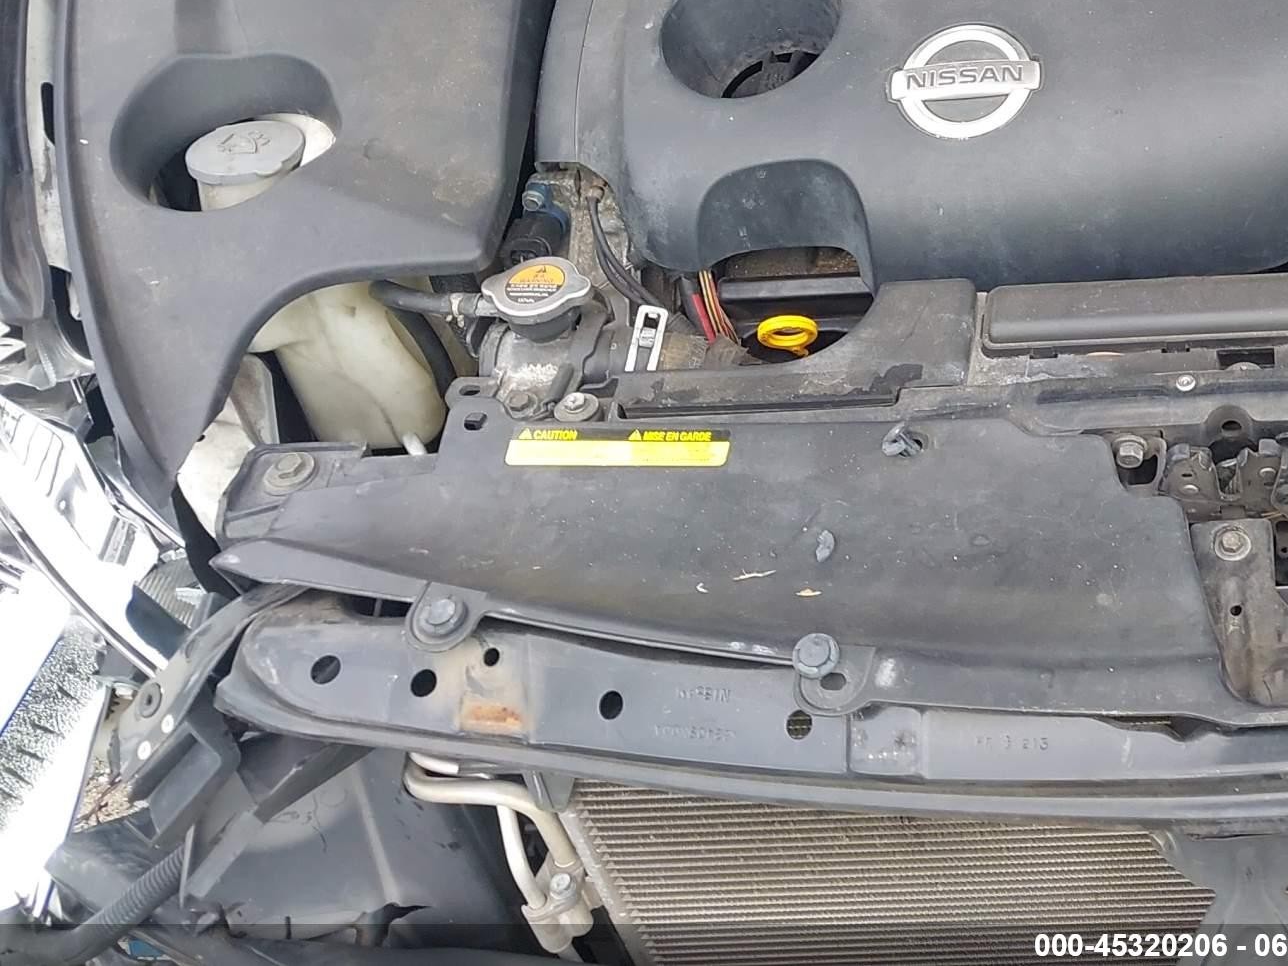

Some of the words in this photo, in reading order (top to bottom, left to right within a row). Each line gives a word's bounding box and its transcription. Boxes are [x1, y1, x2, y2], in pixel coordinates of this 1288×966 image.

[906, 65, 1024, 91] NISSAN
[533, 429, 578, 441] CAUTION
[643, 431, 665, 442] MISE
[666, 432, 679, 442] EN
[680, 431, 712, 442] GARDE
